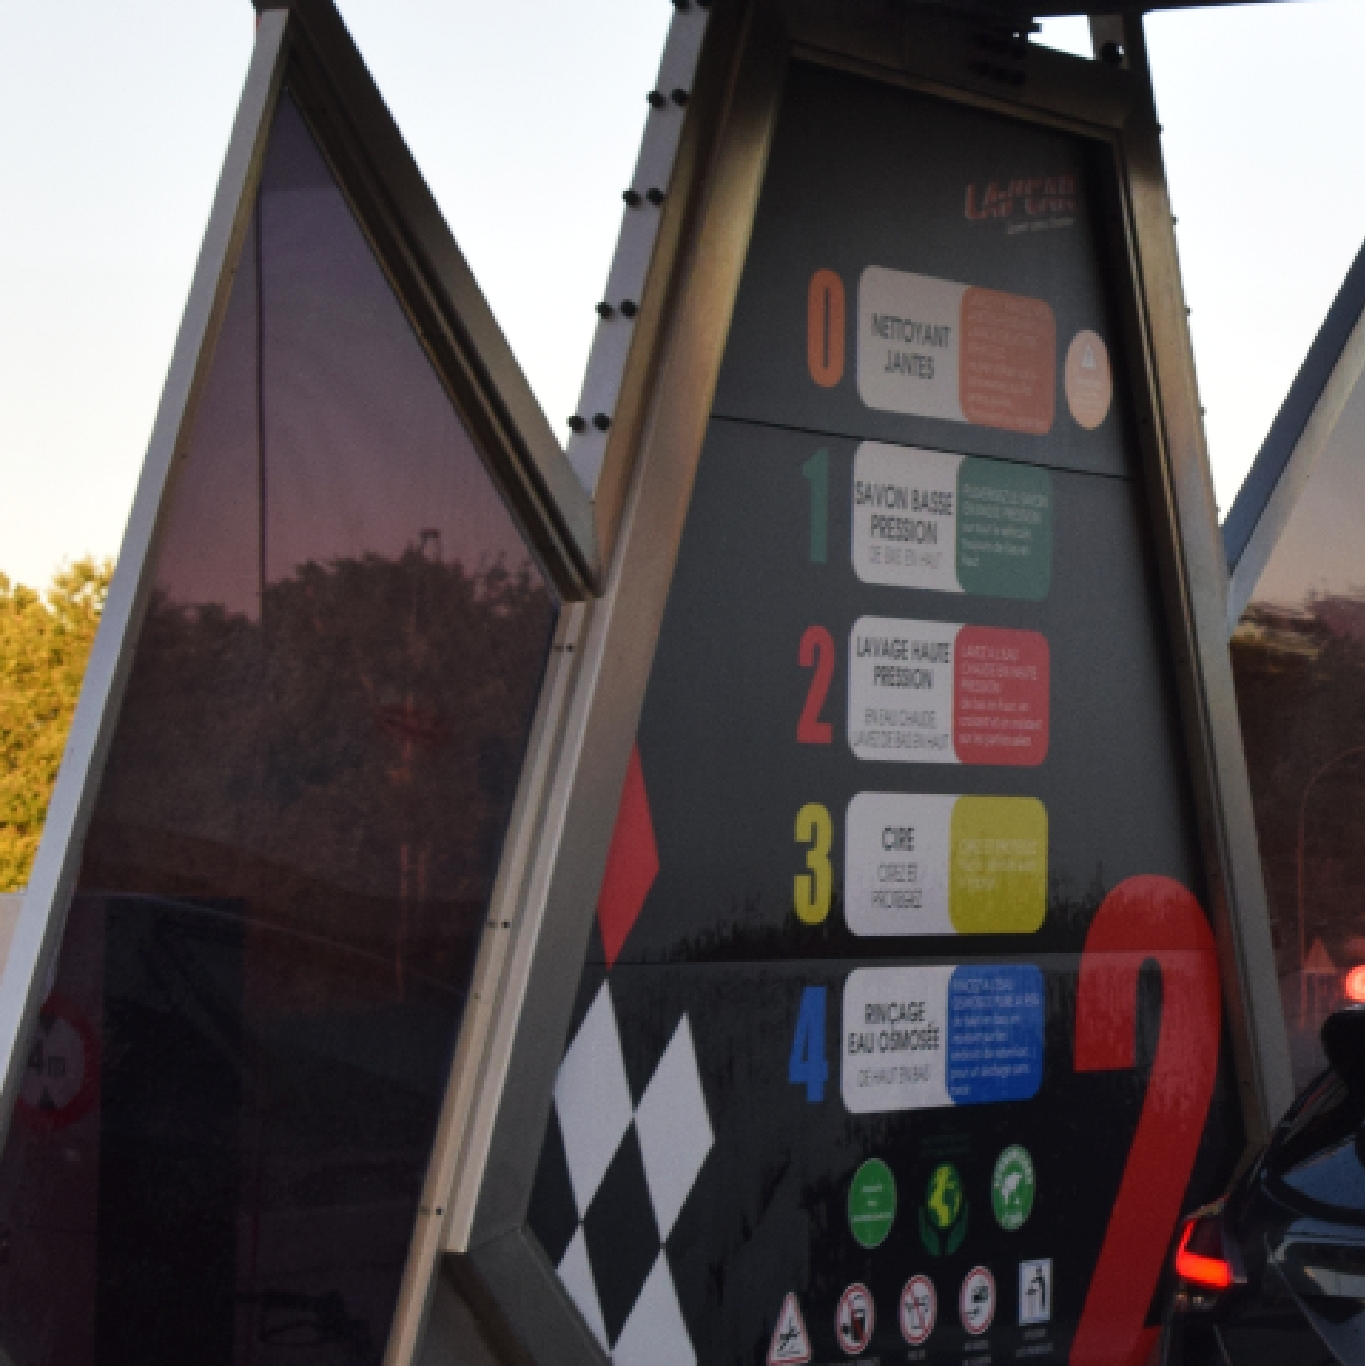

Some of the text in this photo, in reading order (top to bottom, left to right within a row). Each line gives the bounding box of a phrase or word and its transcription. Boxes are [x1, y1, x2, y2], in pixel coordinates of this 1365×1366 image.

[807, 267, 846, 389] 0
[871, 312, 951, 347] NETTOYANT
[884, 349, 935, 379] JANTES
[802, 447, 829, 565] 1
[856, 481, 908, 509] SAVON
[911, 487, 954, 515] BASSE
[870, 513, 938, 544] PRESSION
[857, 637, 951, 663] LAVAGE HAUTE
[797, 624, 835, 745] 2
[873, 665, 934, 689] PRESSION
[882, 826, 914, 852] CIRE
[793, 801, 833, 925] 3
[865, 1002, 925, 1030] RINÇAGE
[788, 986, 828, 1102] 4
[848, 1022, 940, 1055] EAU OSMOSÉE
